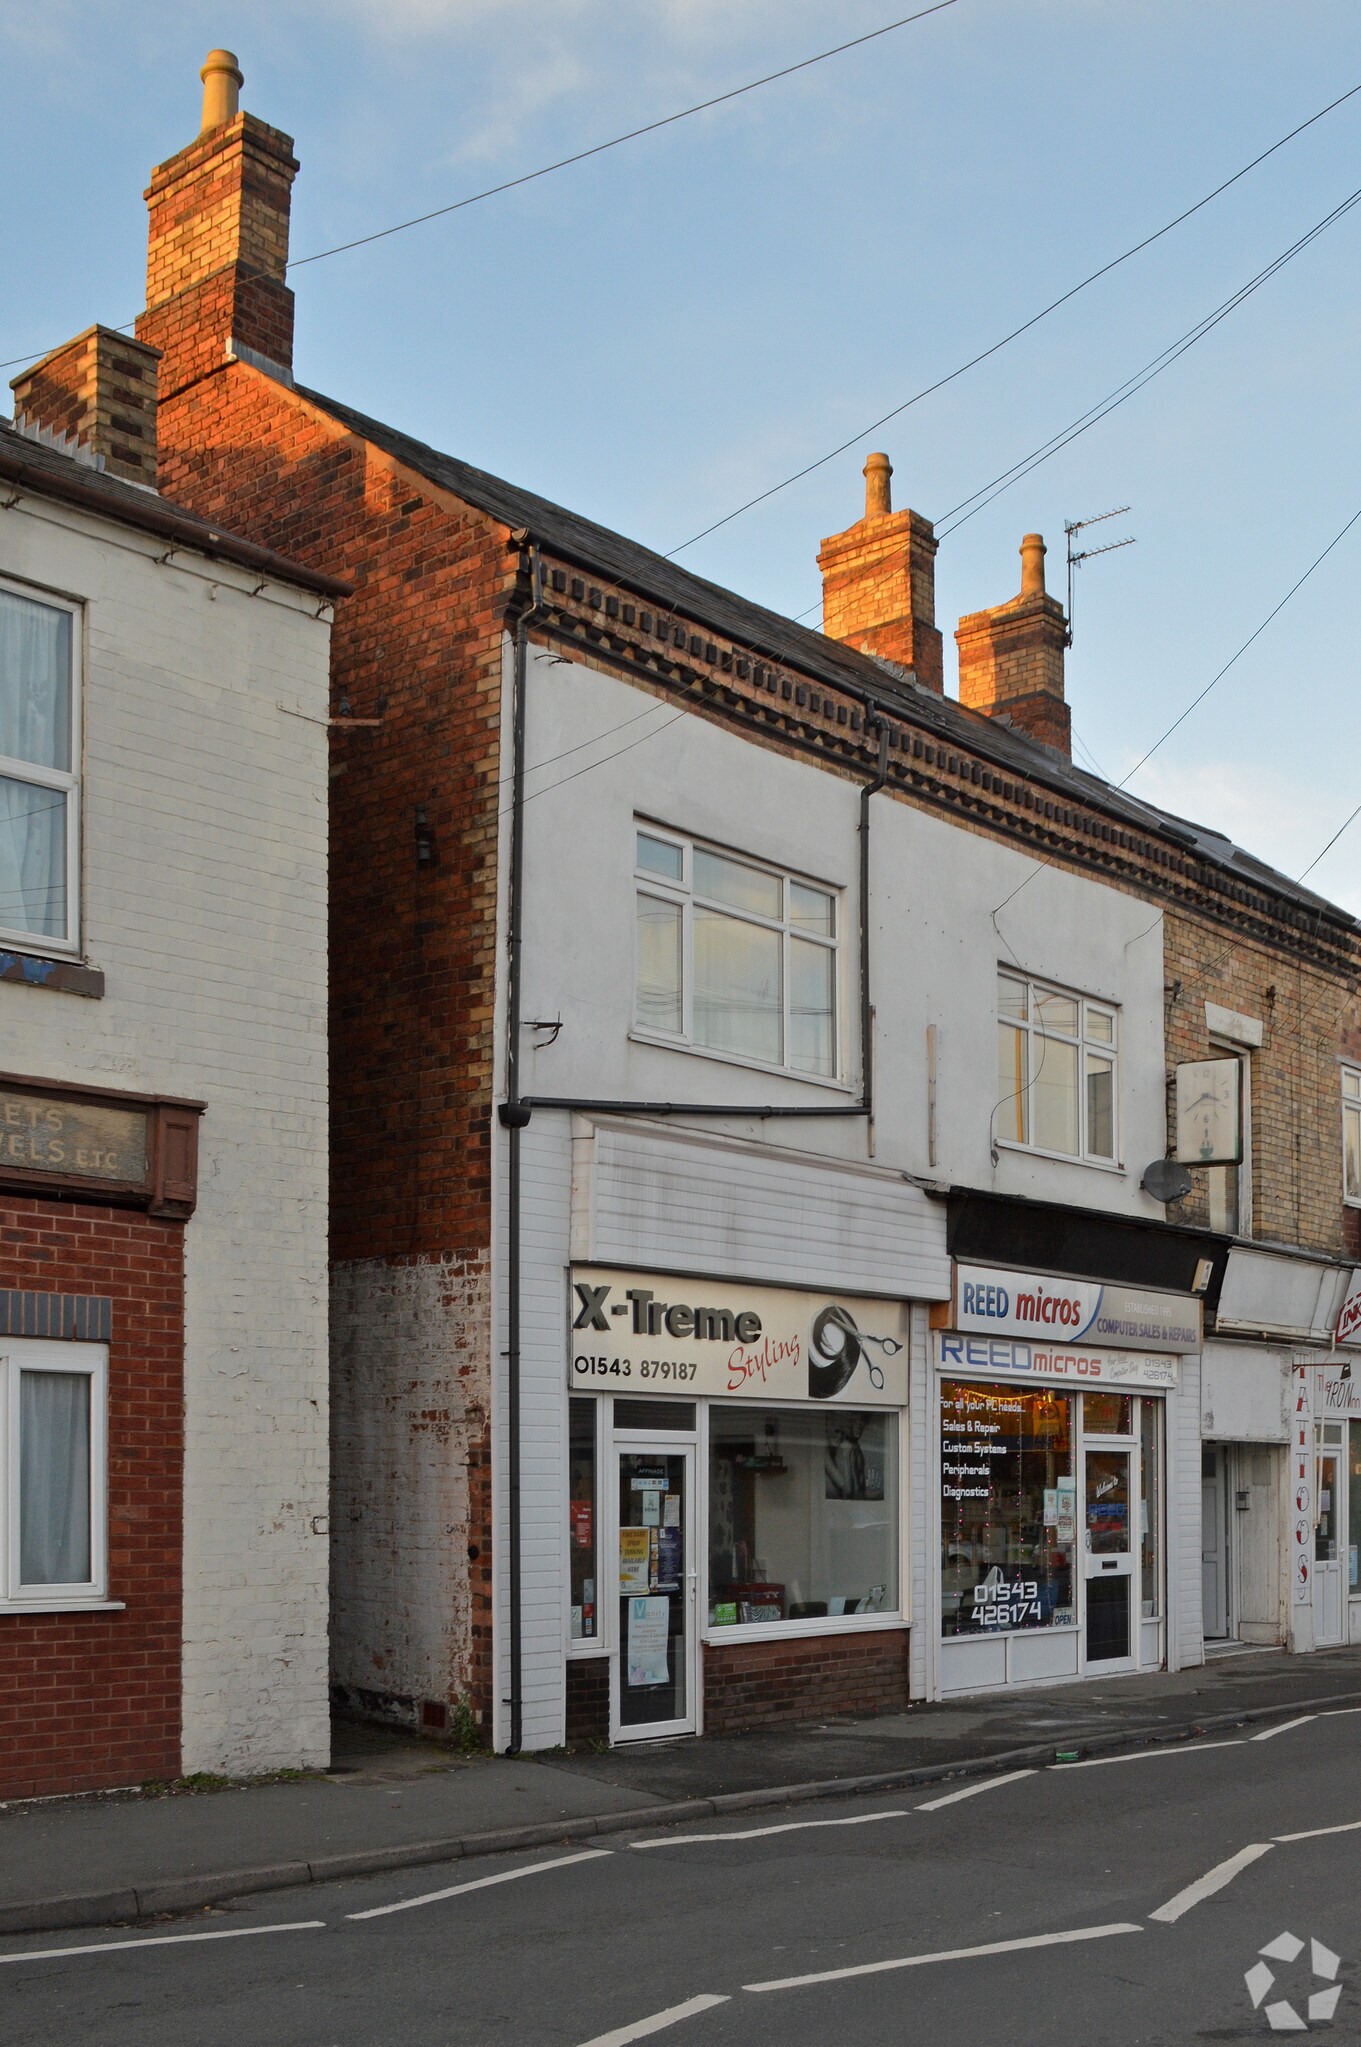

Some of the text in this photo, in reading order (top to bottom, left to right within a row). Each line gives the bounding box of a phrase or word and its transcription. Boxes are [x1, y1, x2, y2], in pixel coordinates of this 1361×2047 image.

[573, 1283, 763, 1344] X-Treme
[963, 1282, 1081, 1327] REED micros
[1097, 1318, 1197, 1343] COMPUTER SALES & REPAIRS
[727, 1334, 801, 1391] Styling
[941, 1335, 1101, 1376] REED micros
[1144, 1358, 1172, 1369] 01543
[575, 1355, 698, 1381] 01543 879187
[1143, 1369, 1174, 1381] 426174
[955, 1398, 964, 1409] all
[966, 1401, 985, 1413] your
[943, 1419, 1001, 1437] Sales & Repair
[943, 1440, 1007, 1457] Custom Systems
[943, 1462, 990, 1478] Peripherals
[943, 1484, 989, 1500] Diagnostics
[973, 1581, 1038, 1603] 01543
[971, 1602, 1042, 1626] 426174
[1055, 1614, 1072, 1626] OPEN
